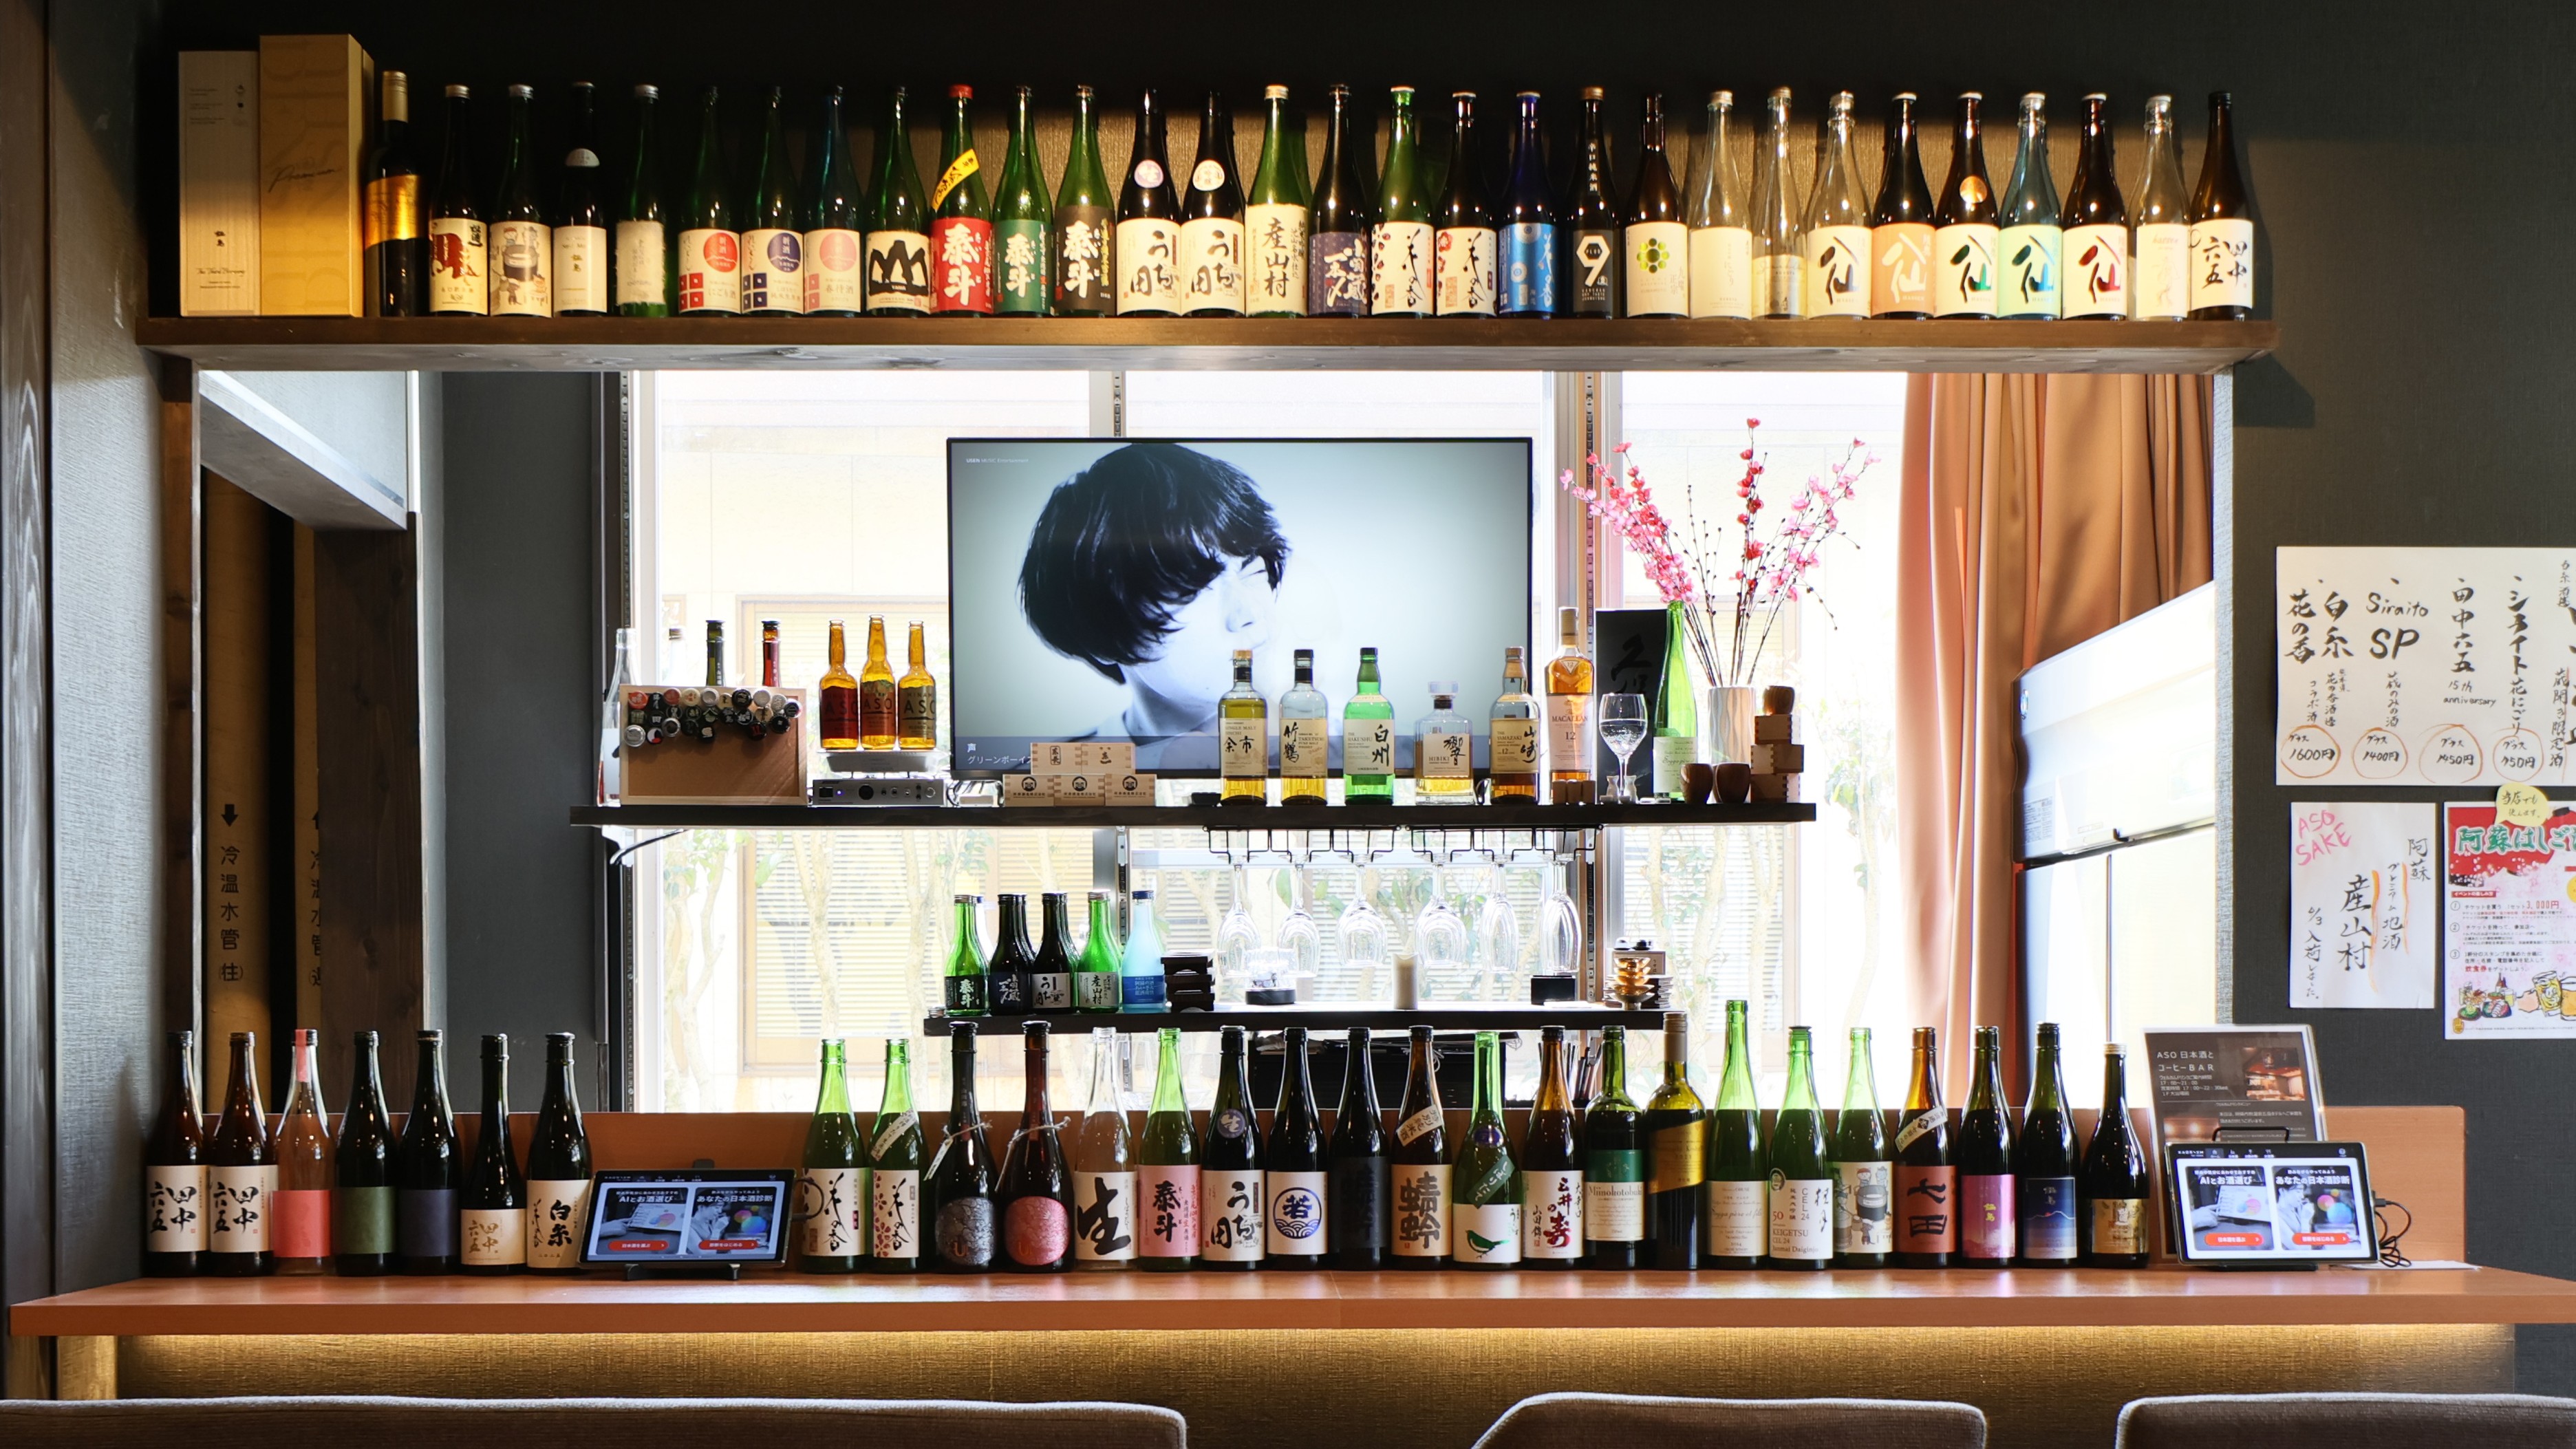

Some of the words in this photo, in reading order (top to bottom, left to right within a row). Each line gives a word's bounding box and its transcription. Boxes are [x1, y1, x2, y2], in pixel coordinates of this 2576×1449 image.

[942, 223, 980, 305] 泰斗
[1005, 233, 1034, 297] 泰斗
[1063, 220, 1098, 299] 泰斗
[1262, 217, 1289, 298] 産山村
[1576, 235, 1610, 287] 9
[2202, 236, 2223, 290] 六五
[2224, 241, 2247, 283] 田中
[2321, 591, 2354, 658] 白糸
[2366, 592, 2429, 618] Siraito
[2284, 588, 2316, 664] 花の香
[2369, 627, 2420, 660] SP
[2451, 586, 2476, 673] 田中六五
[863, 698, 893, 709] ASO
[2306, 680, 2317, 722] コラボ酒
[2385, 672, 2401, 728] 蔵のみの酒
[2443, 696, 2496, 708] anniversary
[967, 743, 976, 753] 声
[1224, 736, 1254, 753] 余市
[1283, 722, 1299, 763] 竹鶴
[1372, 724, 1389, 767] 白州
[1443, 736, 1466, 766] 響
[1521, 725, 1538, 764] 山崎
[1565, 731, 1576, 740] 12
[2289, 734, 2309, 743] グラス
[2289, 748, 2336, 761] 1600円
[2367, 735, 2387, 745] グラス
[2440, 737, 2464, 748] グラス
[2502, 740, 2527, 750] グラス
[2363, 751, 2399, 762] 1400円
[2502, 790, 2538, 805] 当店でも
[2297, 809, 2335, 839] ASO
[2458, 825, 2576, 852] 阿蘇はしご
[2295, 822, 2352, 867] SAKE
[218, 846, 244, 982] 冷温水管(往)
[2337, 874, 2372, 972] 産山村
[2382, 862, 2405, 951] プレミアム地酒
[1091, 974, 1103, 1005] 産山村
[2157, 1051, 2178, 1059] ASO
[2180, 1051, 2214, 1059] 日本酒と
[1588, 1185, 1642, 1196] Miinokotobuki
[2200, 1176, 2252, 1185] AIとお酒選び
[2275, 1176, 2350, 1185] あなたの日本酒診断
[150, 1181, 168, 1234] 六五
[166, 1186, 197, 1233] 田中
[213, 1181, 230, 1234] 六五
[228, 1186, 259, 1233] 田中
[548, 1199, 572, 1247] 白糸
[1153, 1180, 1181, 1243] 泰斗
[1282, 1195, 1312, 1219] 若
[1543, 1177, 1572, 1248] 三井の寿
[1772, 1210, 1783, 1221] 50
[1907, 1178, 1946, 1236] 七田
[468, 1220, 480, 1254] 六五
[479, 1222, 499, 1254] 田中
